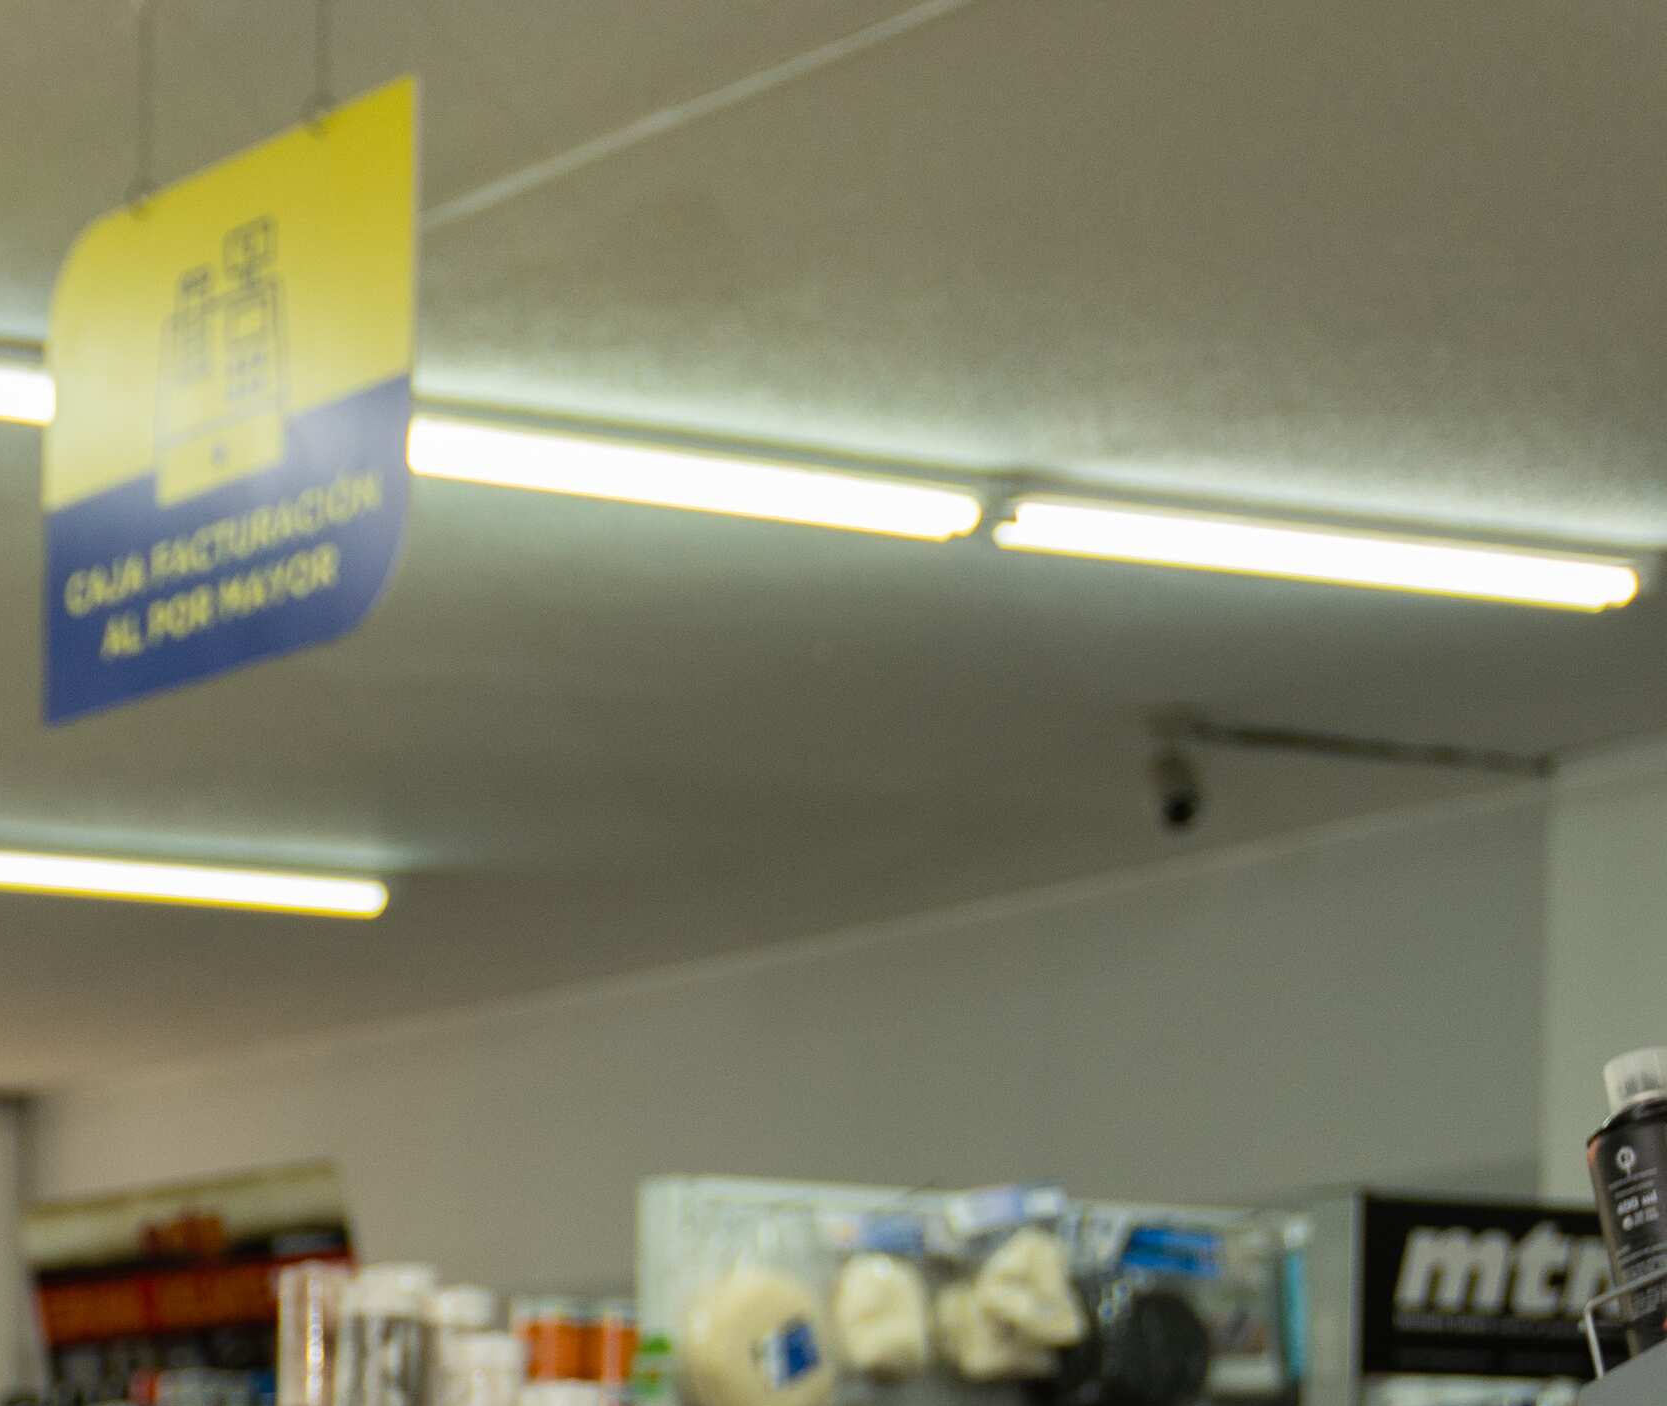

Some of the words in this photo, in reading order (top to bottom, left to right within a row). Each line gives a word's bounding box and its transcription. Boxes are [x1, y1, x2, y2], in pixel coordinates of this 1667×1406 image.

[65, 551, 145, 617] CAJA
[101, 607, 142, 662] AL
[145, 583, 214, 647] POR
[218, 541, 340, 622] MAYOR
